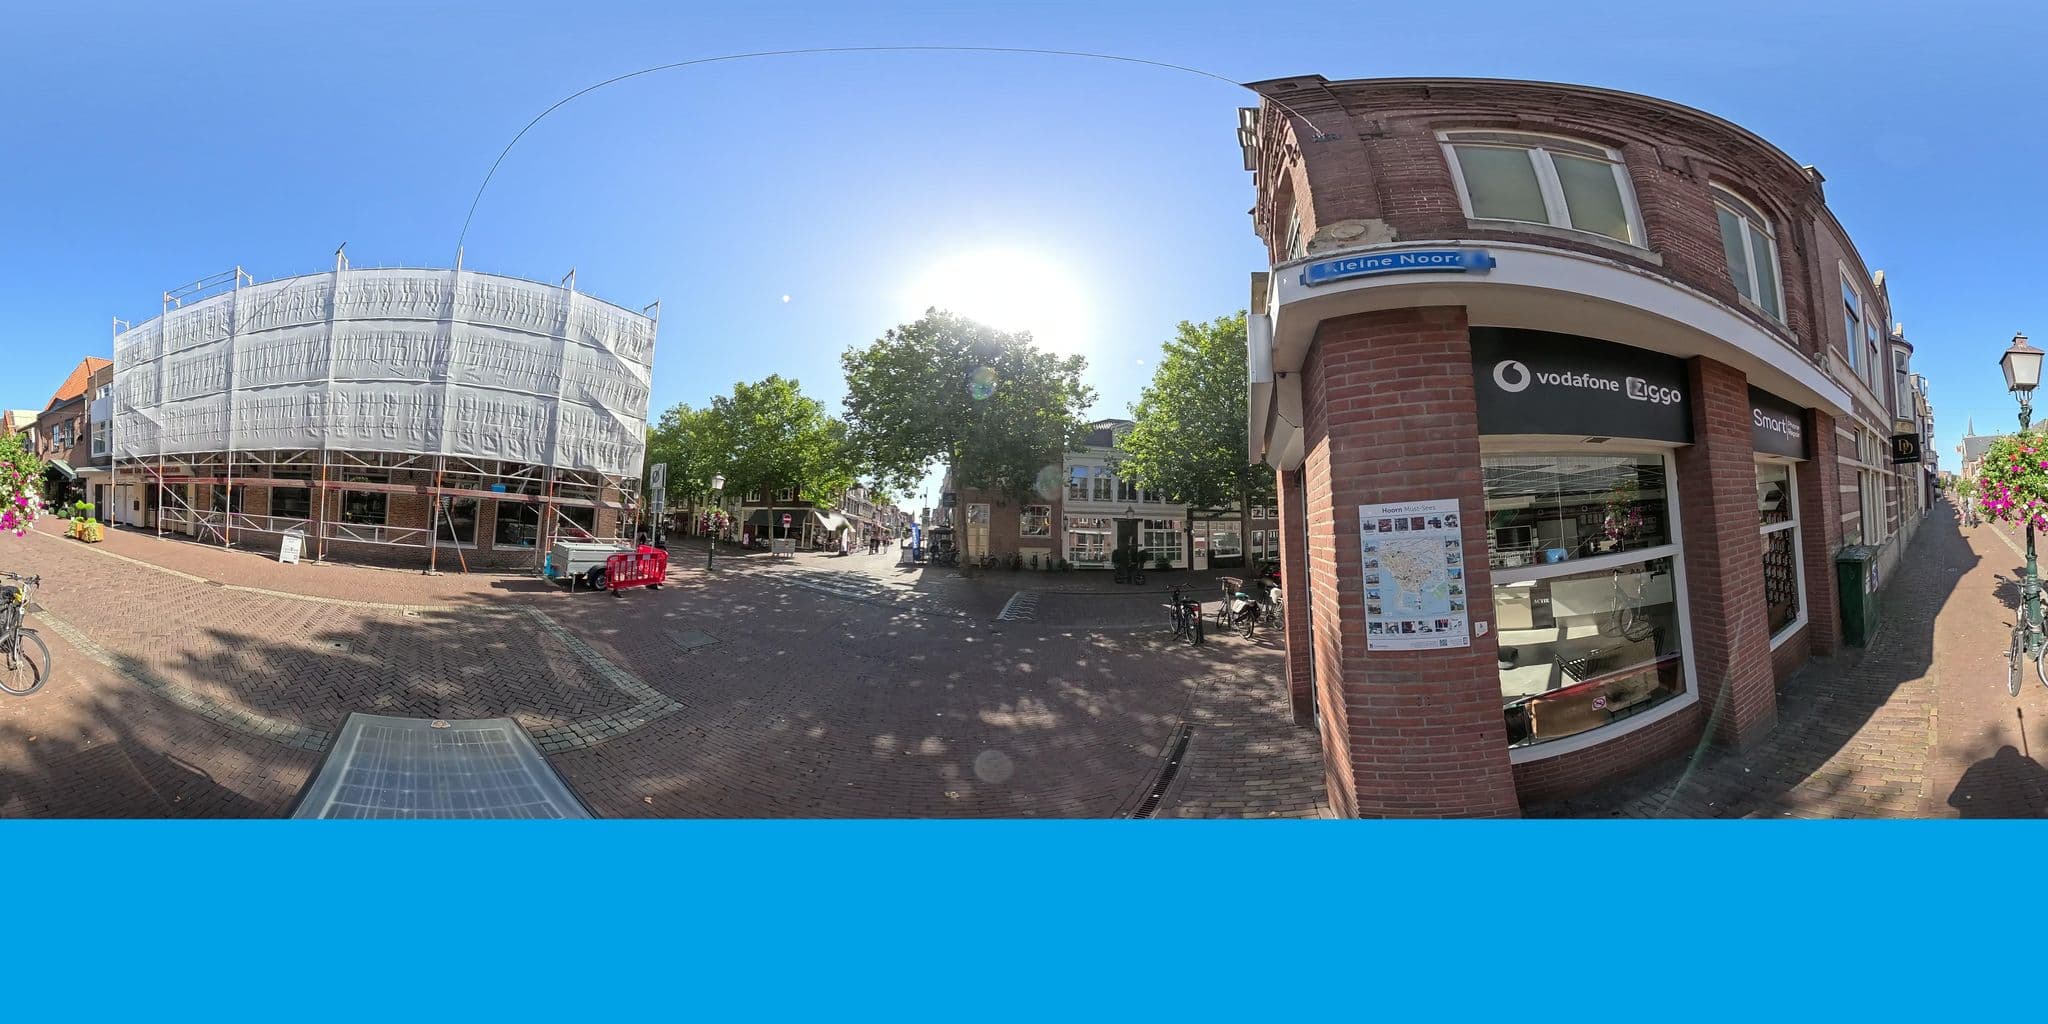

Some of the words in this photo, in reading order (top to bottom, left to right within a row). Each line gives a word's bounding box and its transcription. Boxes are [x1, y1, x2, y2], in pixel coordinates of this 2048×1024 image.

[1536, 371, 1620, 392] vodafone
[1753, 408, 1787, 434] Smart
[1381, 506, 1403, 514] Hoorn
